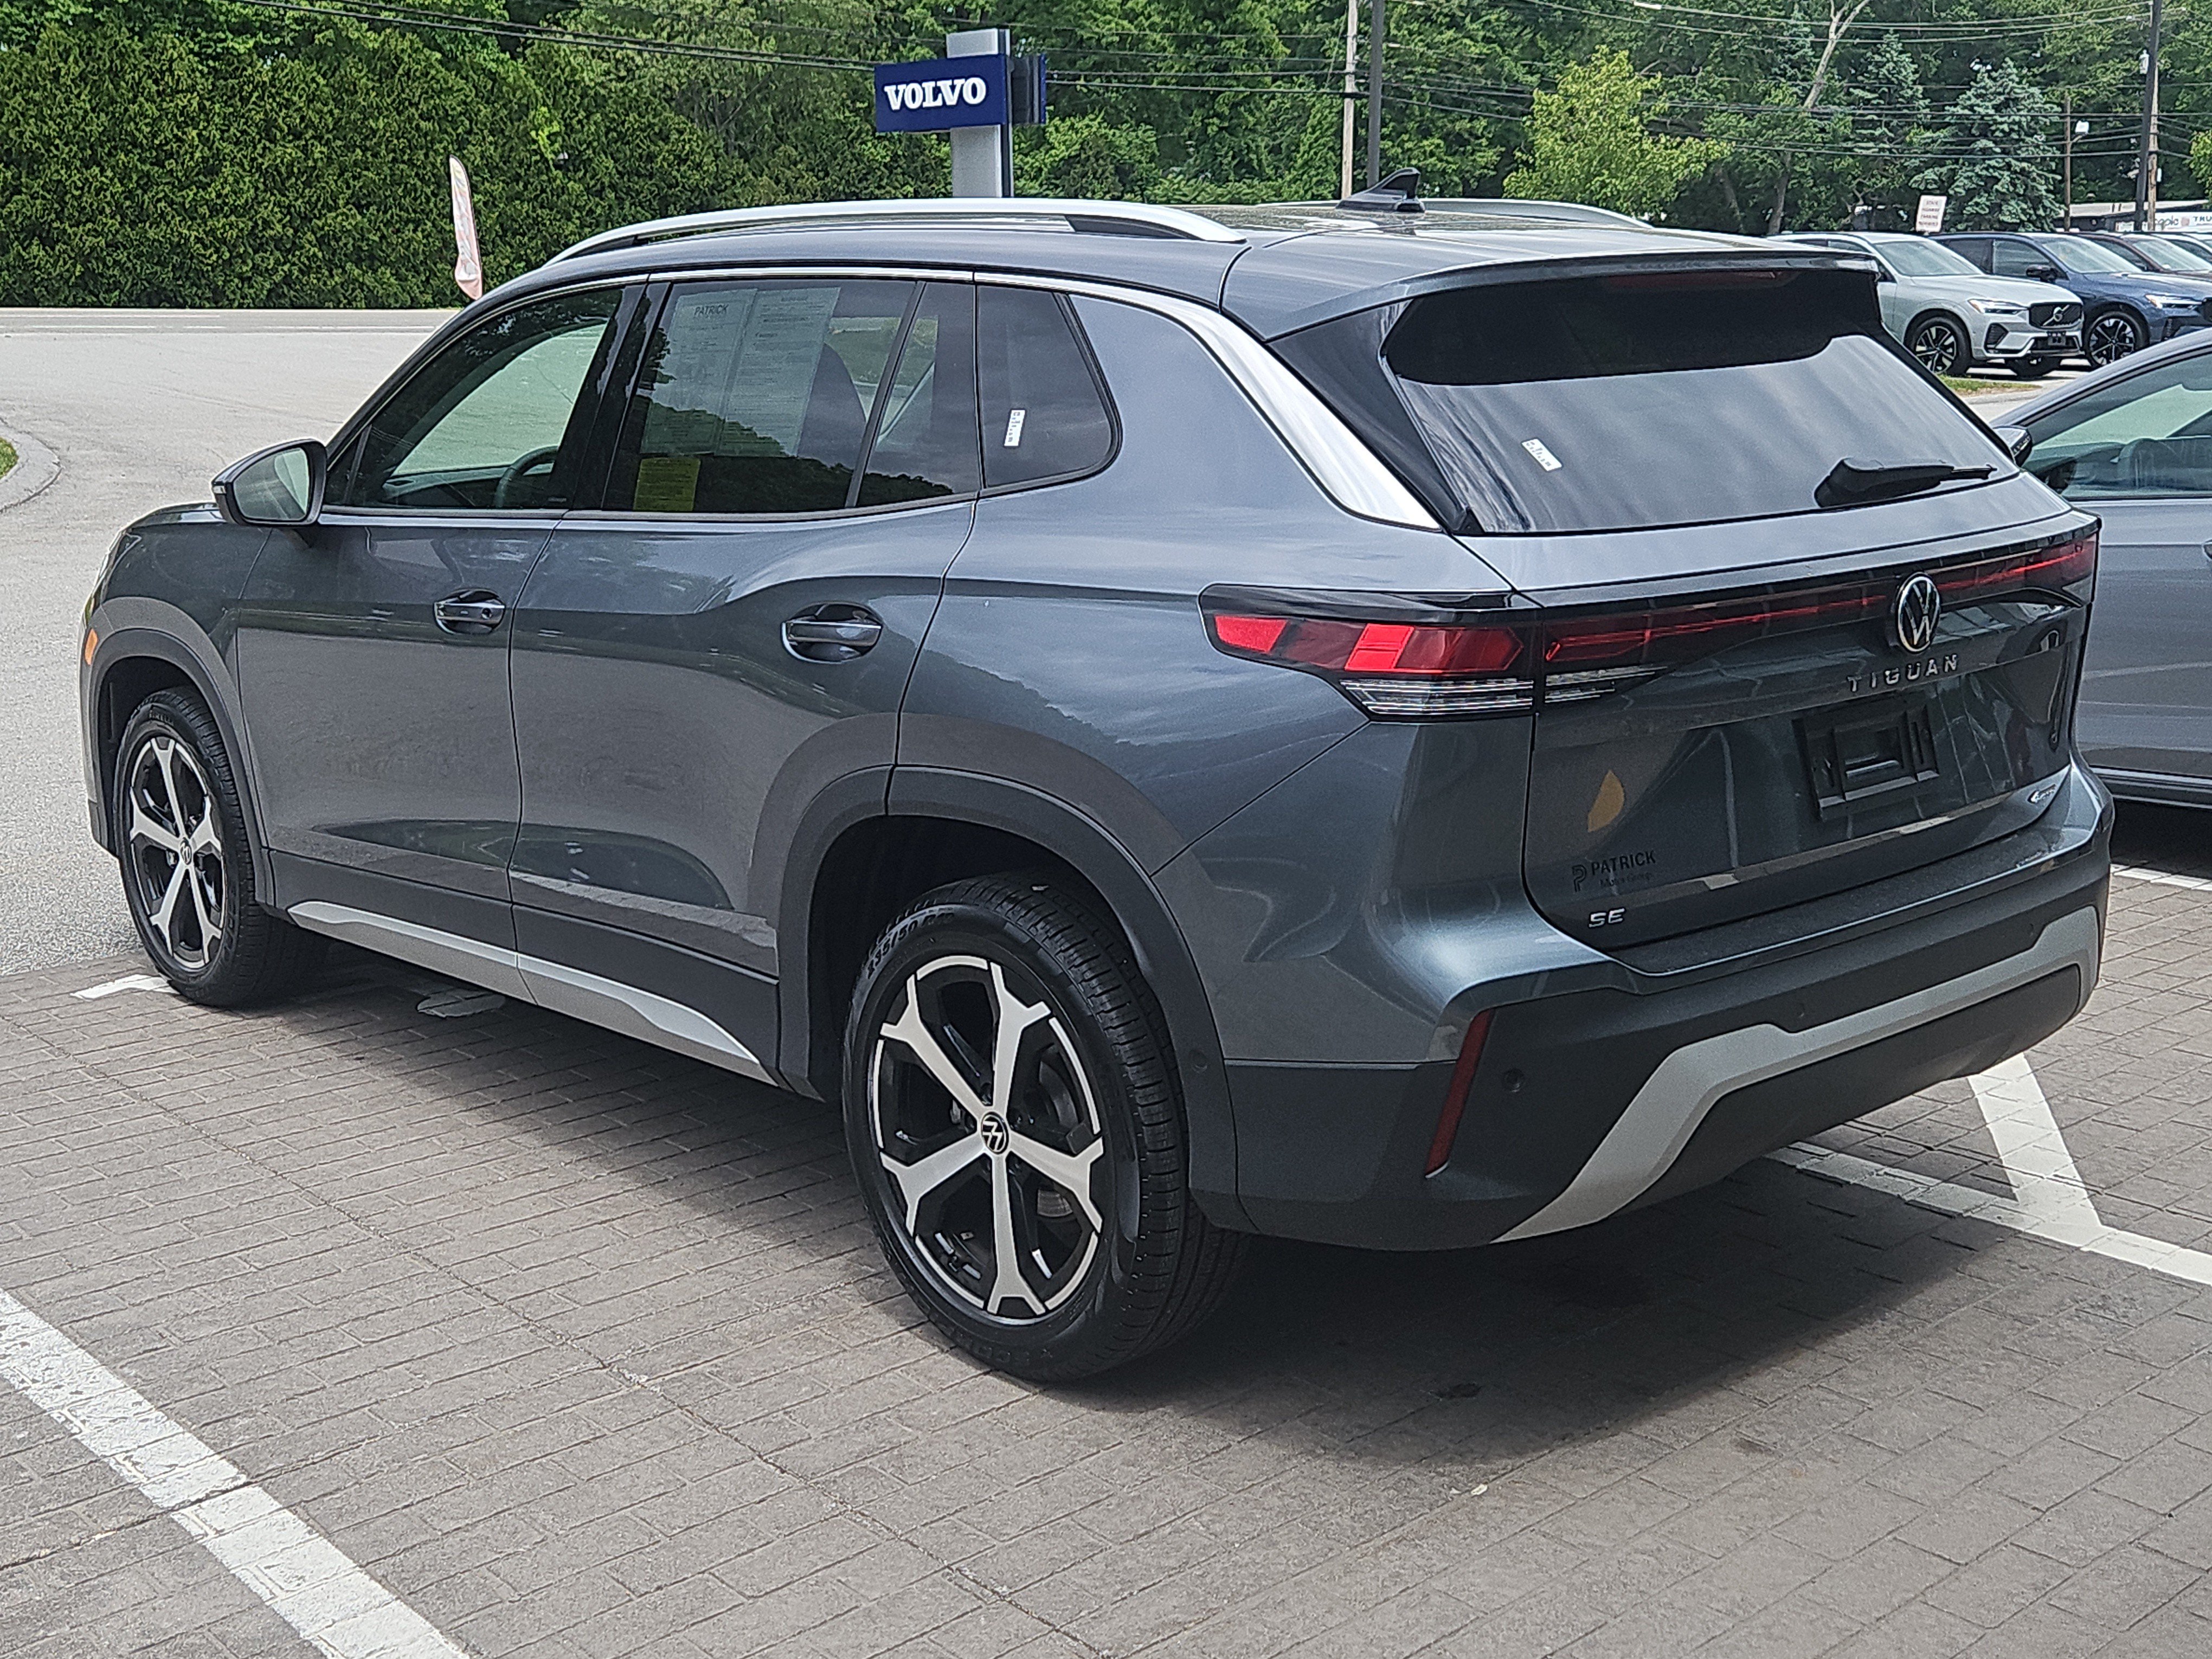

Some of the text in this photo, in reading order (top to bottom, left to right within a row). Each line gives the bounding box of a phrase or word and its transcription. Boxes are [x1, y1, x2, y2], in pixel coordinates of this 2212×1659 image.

[884, 78, 986, 110] VOLVO
[694, 304, 729, 317] PATRICK
[1848, 654, 1957, 692] TIGUAN
[1591, 850, 1656, 875] PATRICK
[1589, 907, 1625, 928] SE
